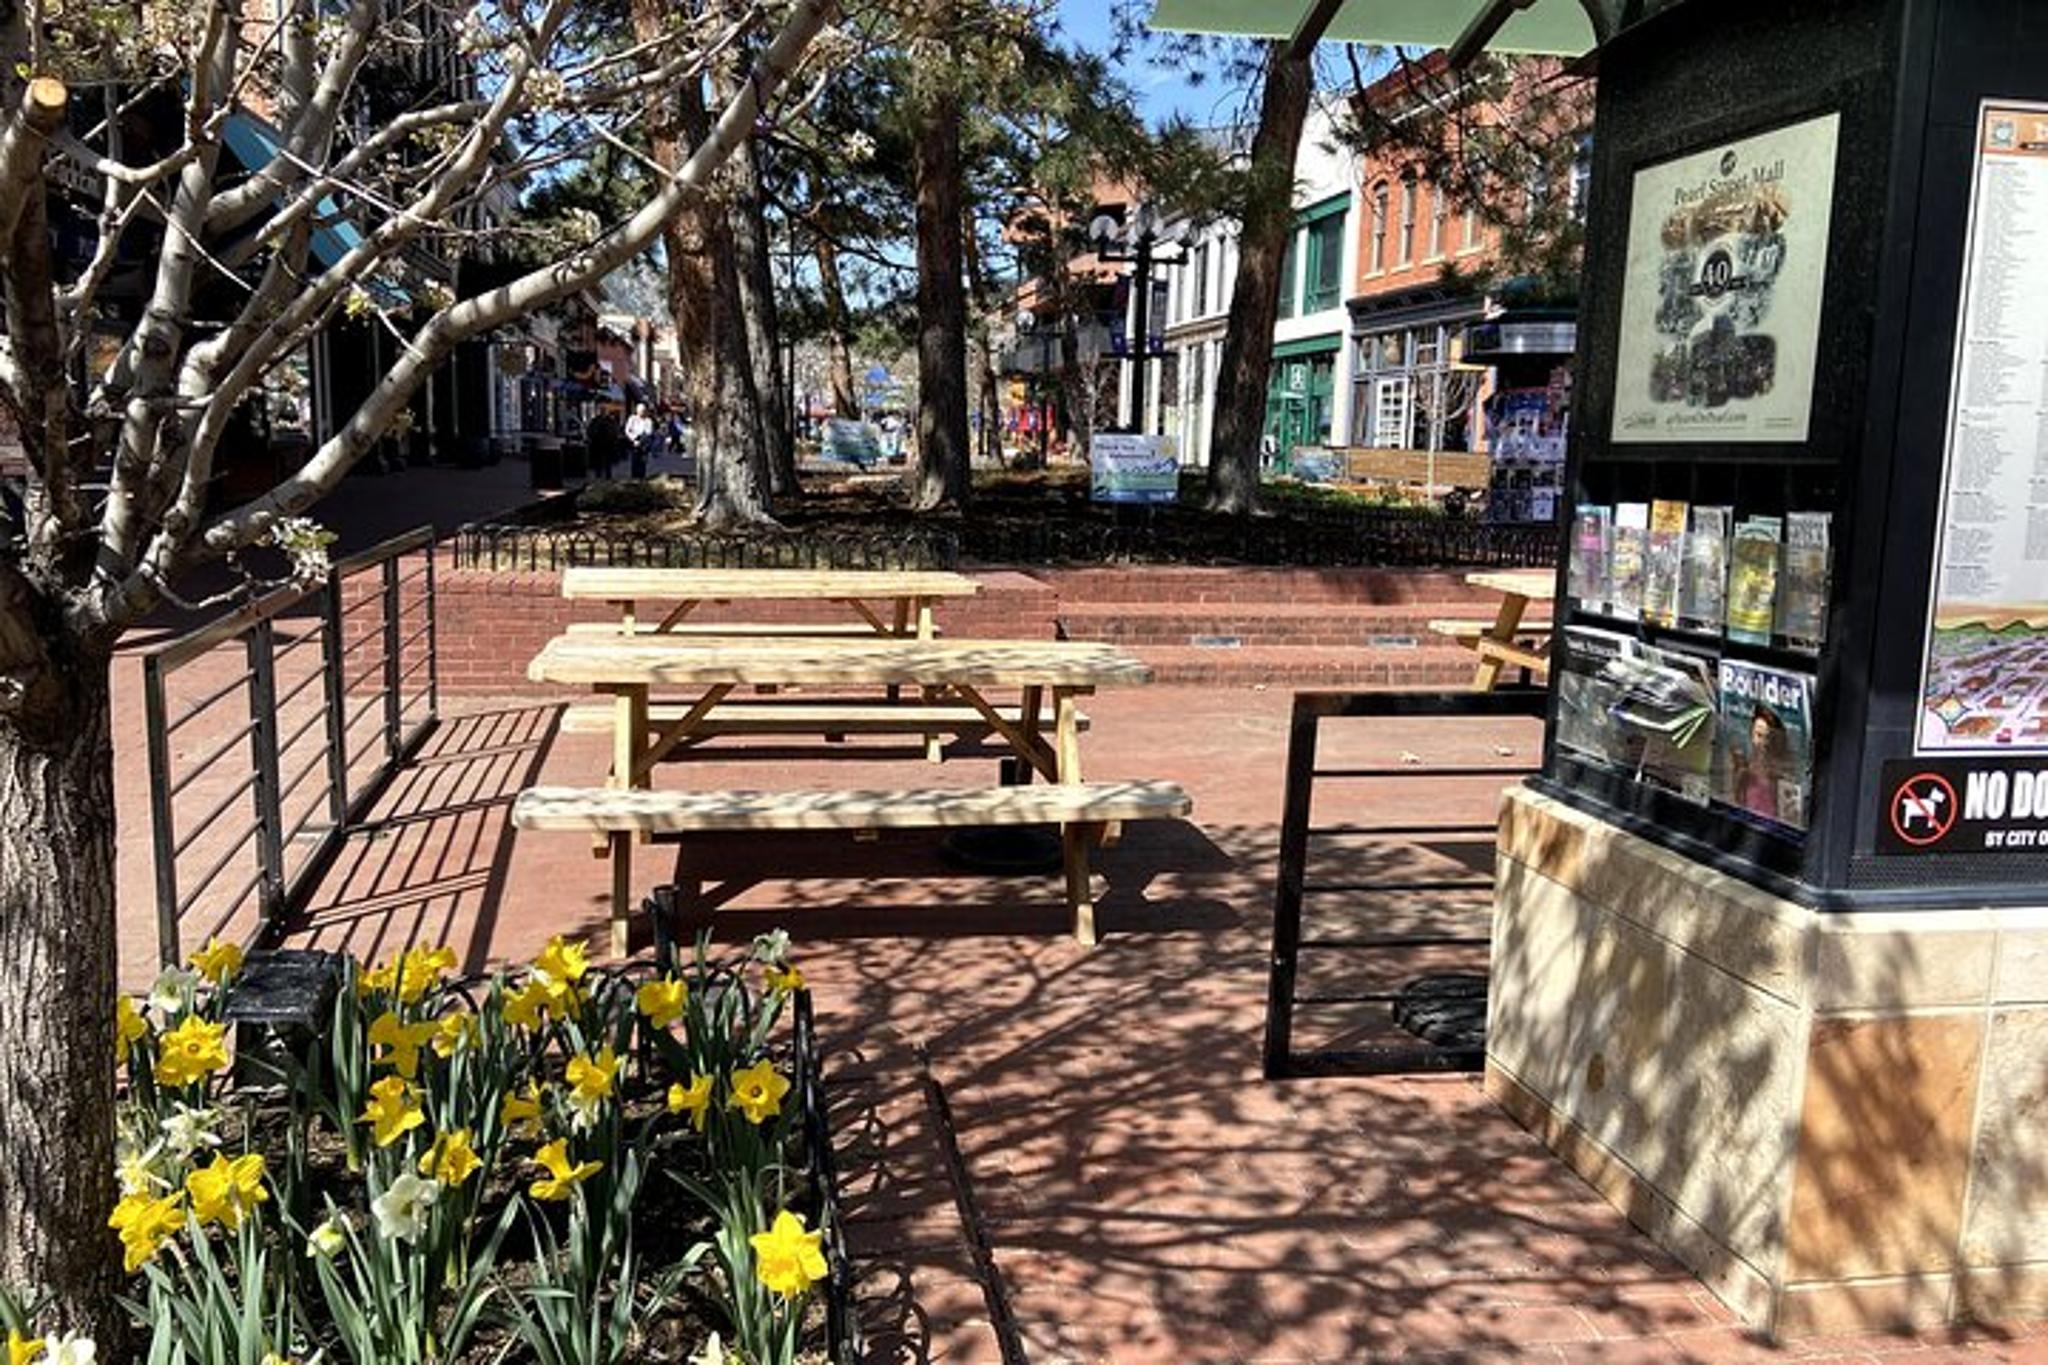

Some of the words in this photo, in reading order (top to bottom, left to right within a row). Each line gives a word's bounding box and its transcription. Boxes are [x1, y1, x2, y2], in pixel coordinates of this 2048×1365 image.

[1674, 180, 1707, 205] Pearl
[1751, 158, 1785, 182] Mall
[1704, 260, 1729, 287] 40
[1720, 663, 1801, 710] Boulder
[1964, 769, 2009, 820] NO
[2010, 769, 2048, 820] DO
[1984, 829, 2007, 849] BY
[2005, 828, 2038, 847] CITY
